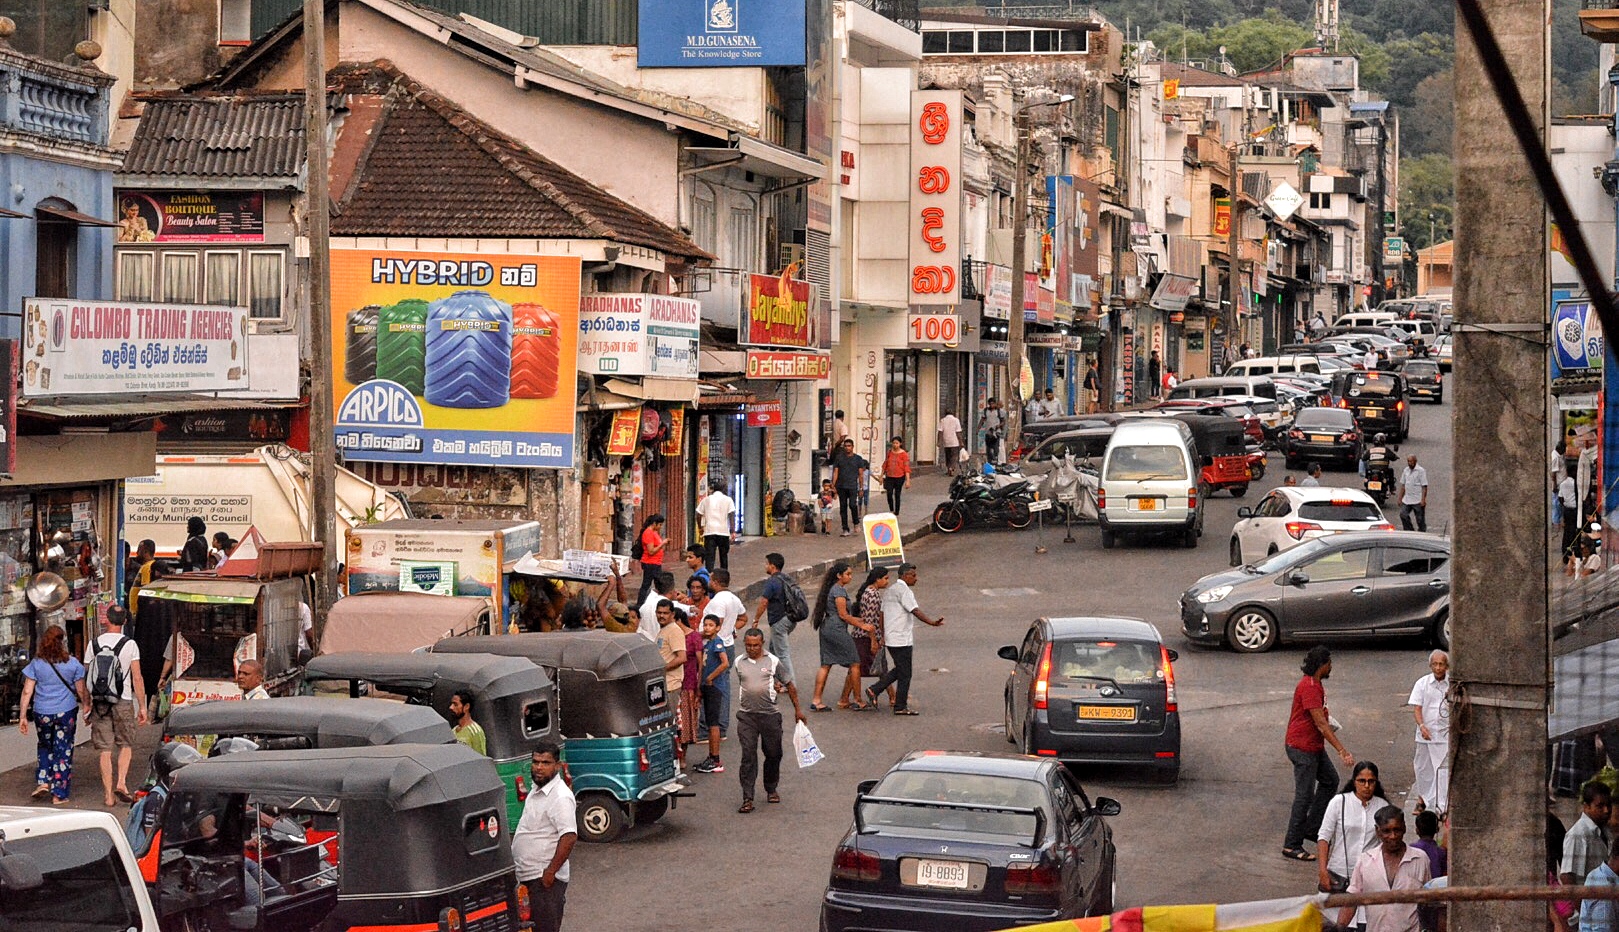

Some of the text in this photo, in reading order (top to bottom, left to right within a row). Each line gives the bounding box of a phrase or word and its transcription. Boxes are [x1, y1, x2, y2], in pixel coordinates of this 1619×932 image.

[687, 35, 757, 47] M.D.GUNASENA
[682, 50, 762, 60] The Knowledge Store
[170, 195, 211, 204] FASHION
[165, 205, 217, 214] BOUTIQUE
[166, 215, 193, 227] Beauty
[194, 215, 217, 226] Salon
[372, 258, 494, 287] HYBRID
[579, 296, 642, 313] ARADHANAS
[650, 299, 697, 324] ARADHANAS
[70, 306, 233, 340] COLOMBO TRADING AGENCIES
[453, 321, 492, 331] HYBRID
[912, 317, 956, 339] 100
[341, 387, 418, 423] ARPICO
[170, 497, 190, 506] මහා
[129, 514, 160, 523] Kandy
[211, 514, 248, 522] Council
[878, 547, 901, 555] PARKING
[921, 864, 965, 881] 19-8893
